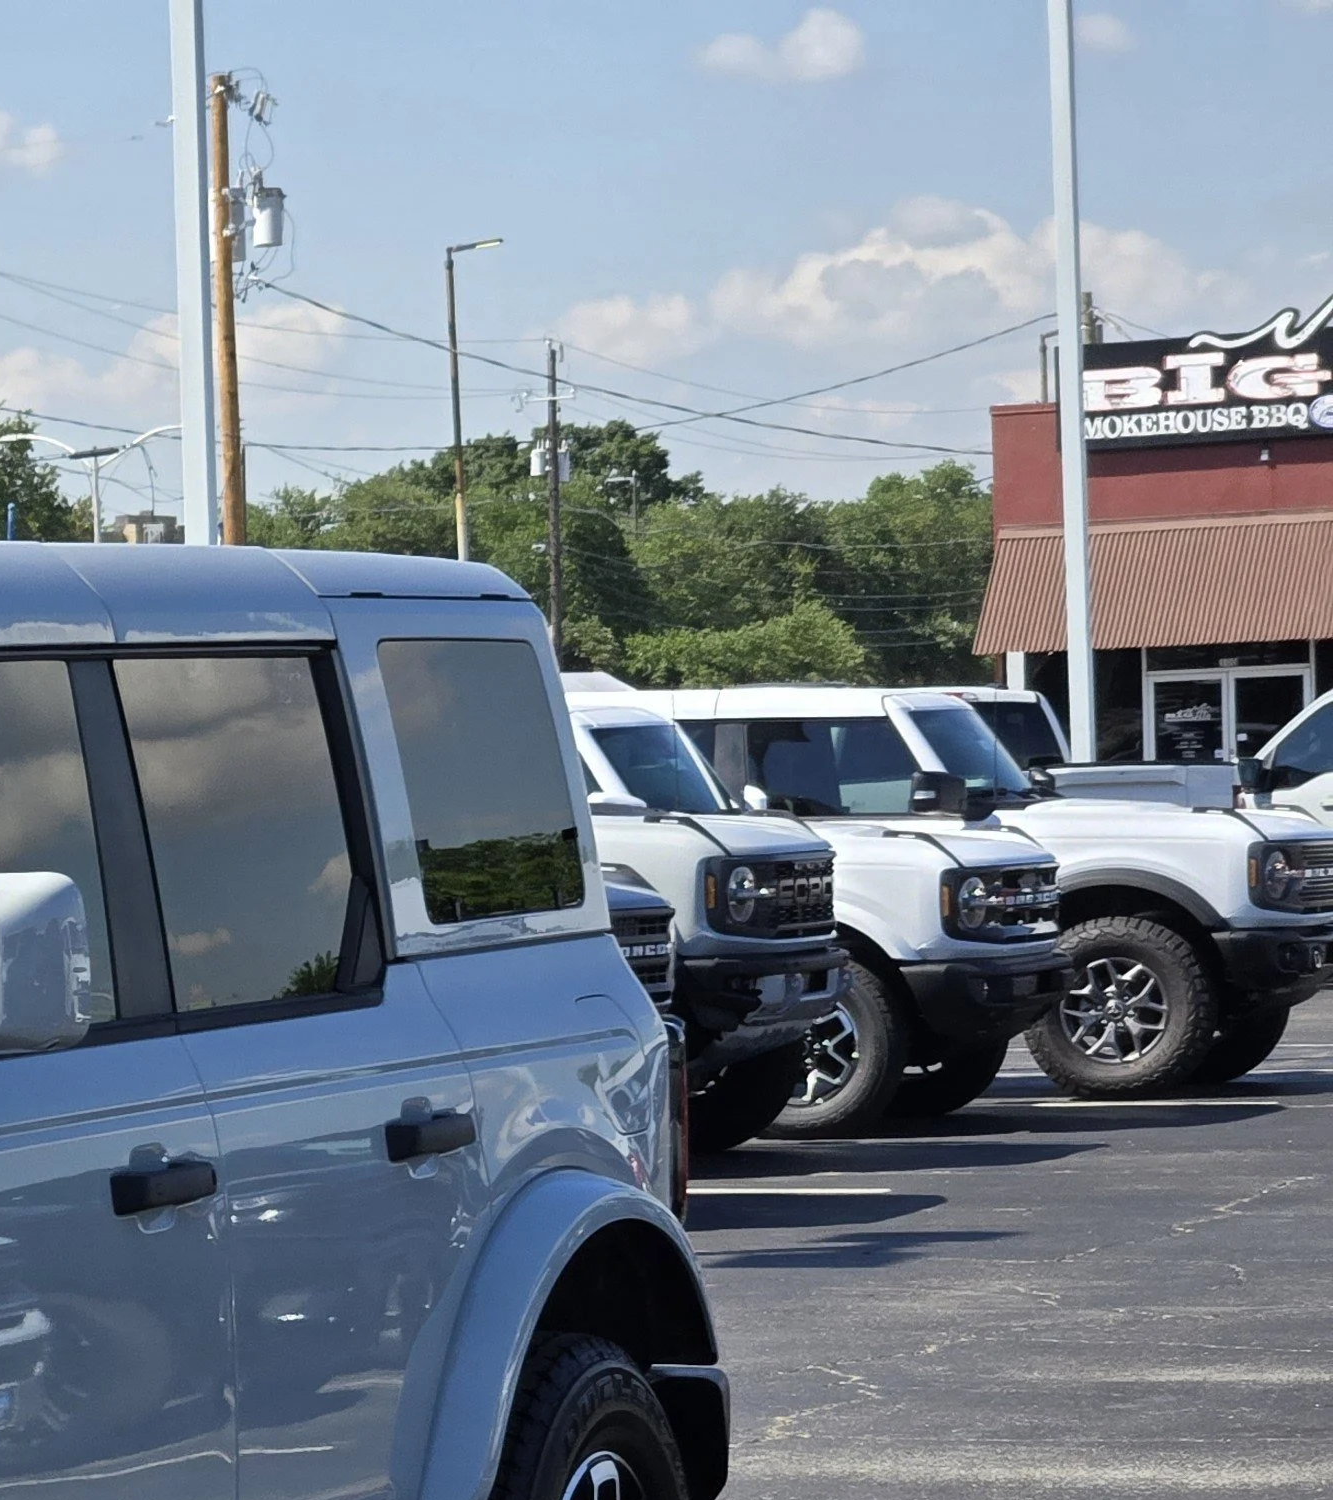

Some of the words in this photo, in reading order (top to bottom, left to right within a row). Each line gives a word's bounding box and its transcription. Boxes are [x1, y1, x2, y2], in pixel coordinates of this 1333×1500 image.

[1083, 352, 1332, 411] BIG
[1084, 406, 1248, 440] MOKEHOUSE
[1249, 402, 1310, 429] BBQ
